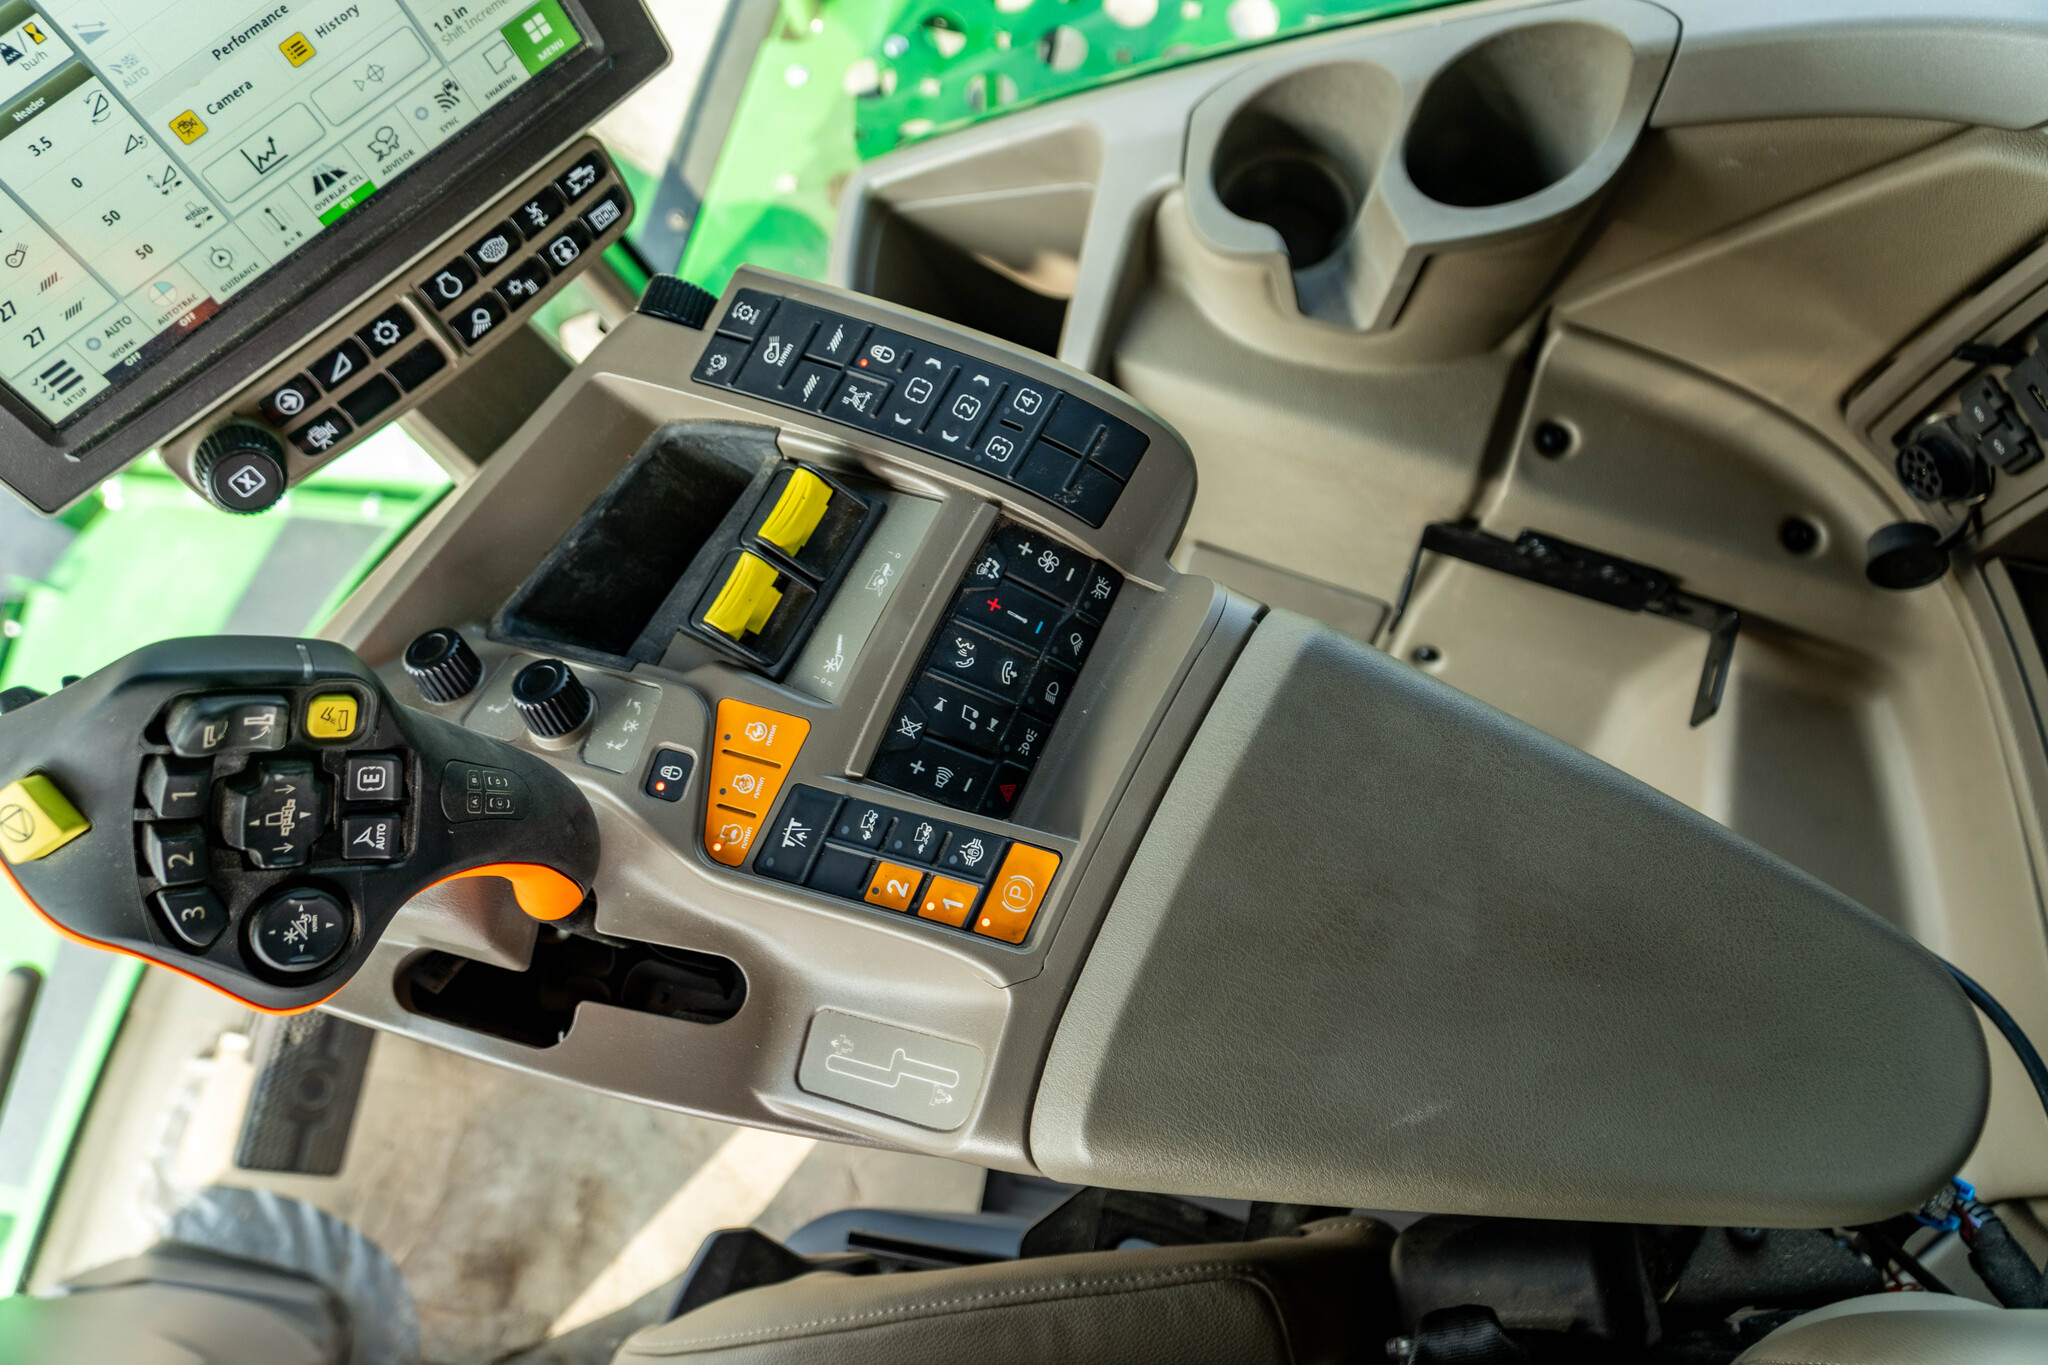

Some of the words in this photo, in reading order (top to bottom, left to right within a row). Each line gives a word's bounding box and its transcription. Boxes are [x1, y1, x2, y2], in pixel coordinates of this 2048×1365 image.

[315, 3, 360, 39] History
[434, 14, 453, 32] 1.0
[452, 6, 468, 20] in
[212, 3, 289, 61] Performance
[441, 26, 467, 46] Shift
[21, 49, 49, 72] bu/h
[537, 38, 565, 62] MENU
[122, 66, 149, 88] AUTO
[484, 74, 518, 101] SHARING
[206, 79, 253, 115] Camera
[12, 96, 46, 122] Header
[439, 117, 459, 133] SYNC
[28, 136, 52, 157] 3.5
[381, 149, 416, 176] ADVISOR
[71, 177, 82, 188] 0
[315, 183, 350, 211] OVERLAP
[350, 173, 365, 190] CTL
[339, 196, 355, 210] ON
[102, 210, 121, 226] 50
[135, 243, 154, 260] 50
[219, 261, 260, 293] GUIDANCE
[157, 293, 198, 326] AUTOTRAC
[178, 311, 197, 327] OFF
[23, 326, 45, 349] 27
[104, 314, 133, 339] AUTO
[108, 337, 137, 360] WORK
[124, 351, 142, 367] OFF
[777, 342, 794, 367] n/min
[63, 385, 88, 407] SETUP
[766, 724, 777, 746] n/min
[171, 791, 197, 801] 1
[753, 777, 765, 799] n/min
[375, 823, 387, 850] AUTO
[741, 826, 753, 849] n/min
[168, 851, 194, 869] 2
[886, 879, 909, 898] 2
[182, 905, 206, 922] 3
[942, 896, 963, 910] 1
